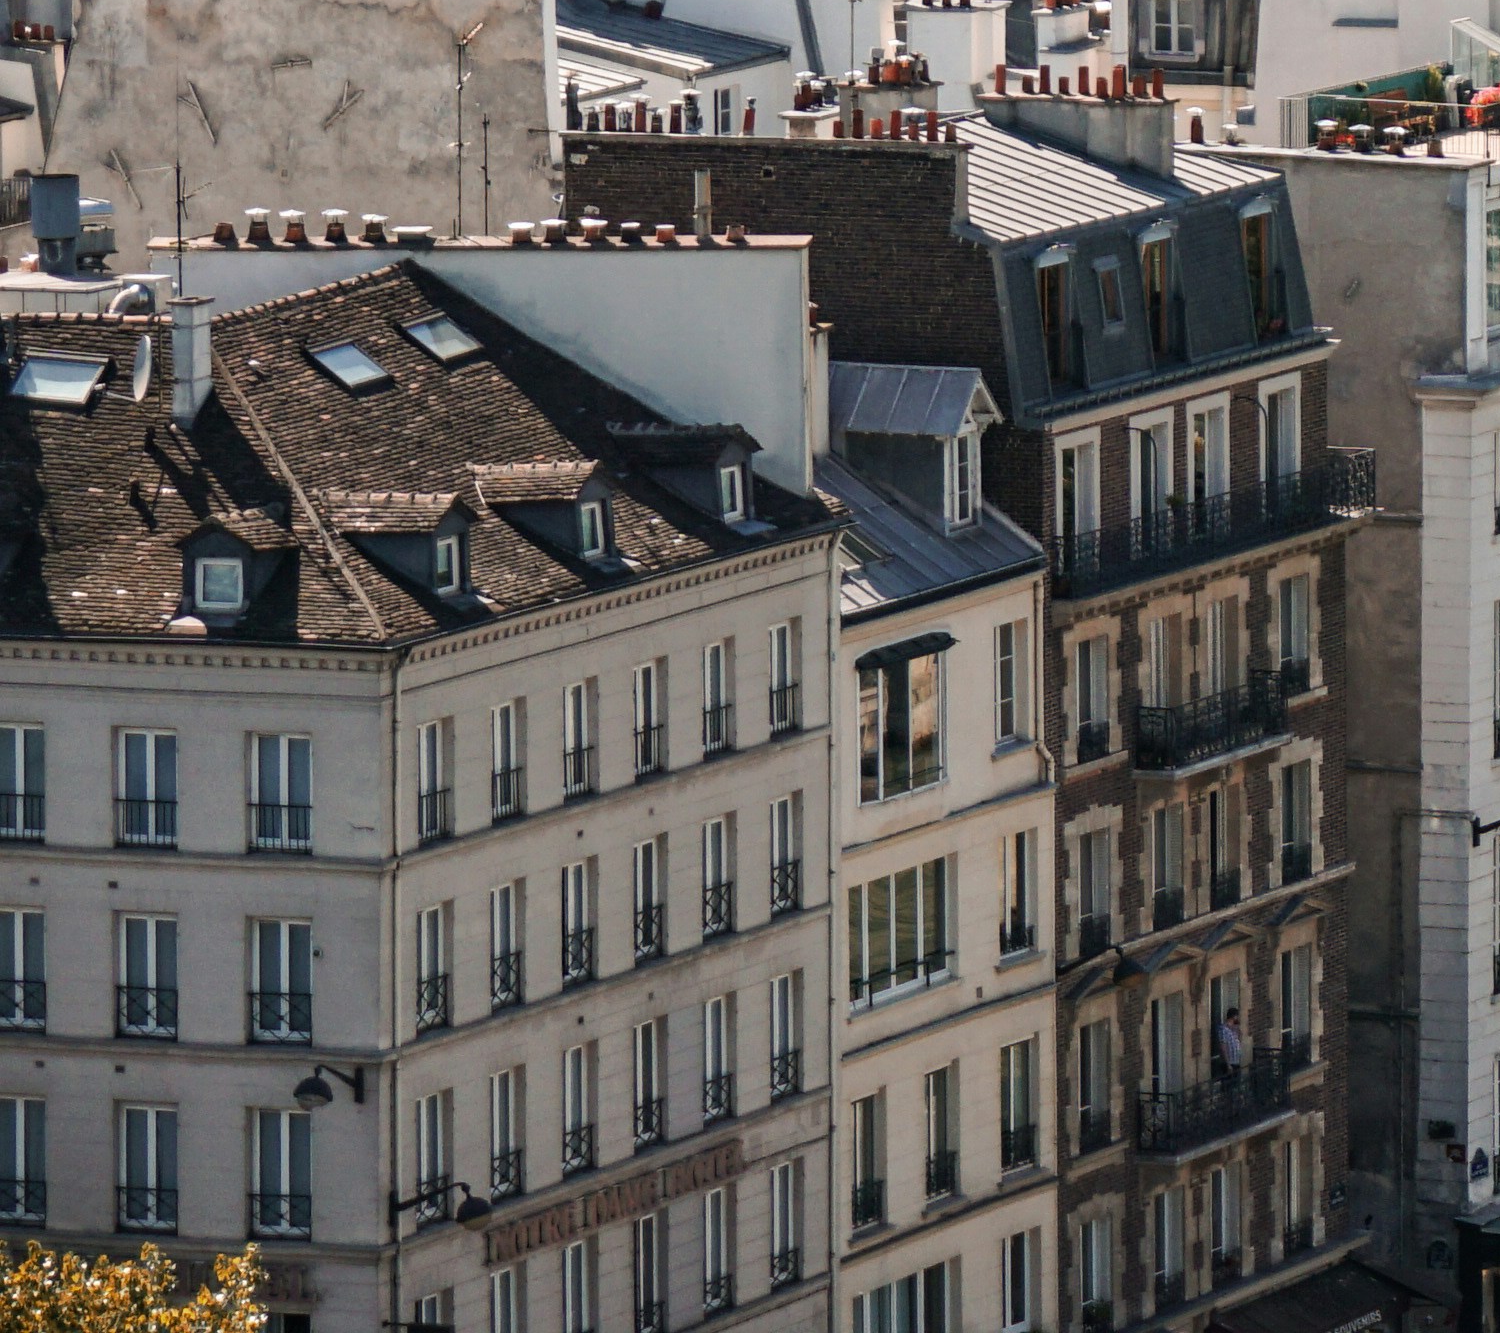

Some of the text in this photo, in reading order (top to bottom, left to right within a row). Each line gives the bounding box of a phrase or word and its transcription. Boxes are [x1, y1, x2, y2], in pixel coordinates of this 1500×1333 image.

[483, 1137, 744, 1266] NOTRE DAME HOTEL
[1334, 1309, 1382, 1333] SOUVENIRS
